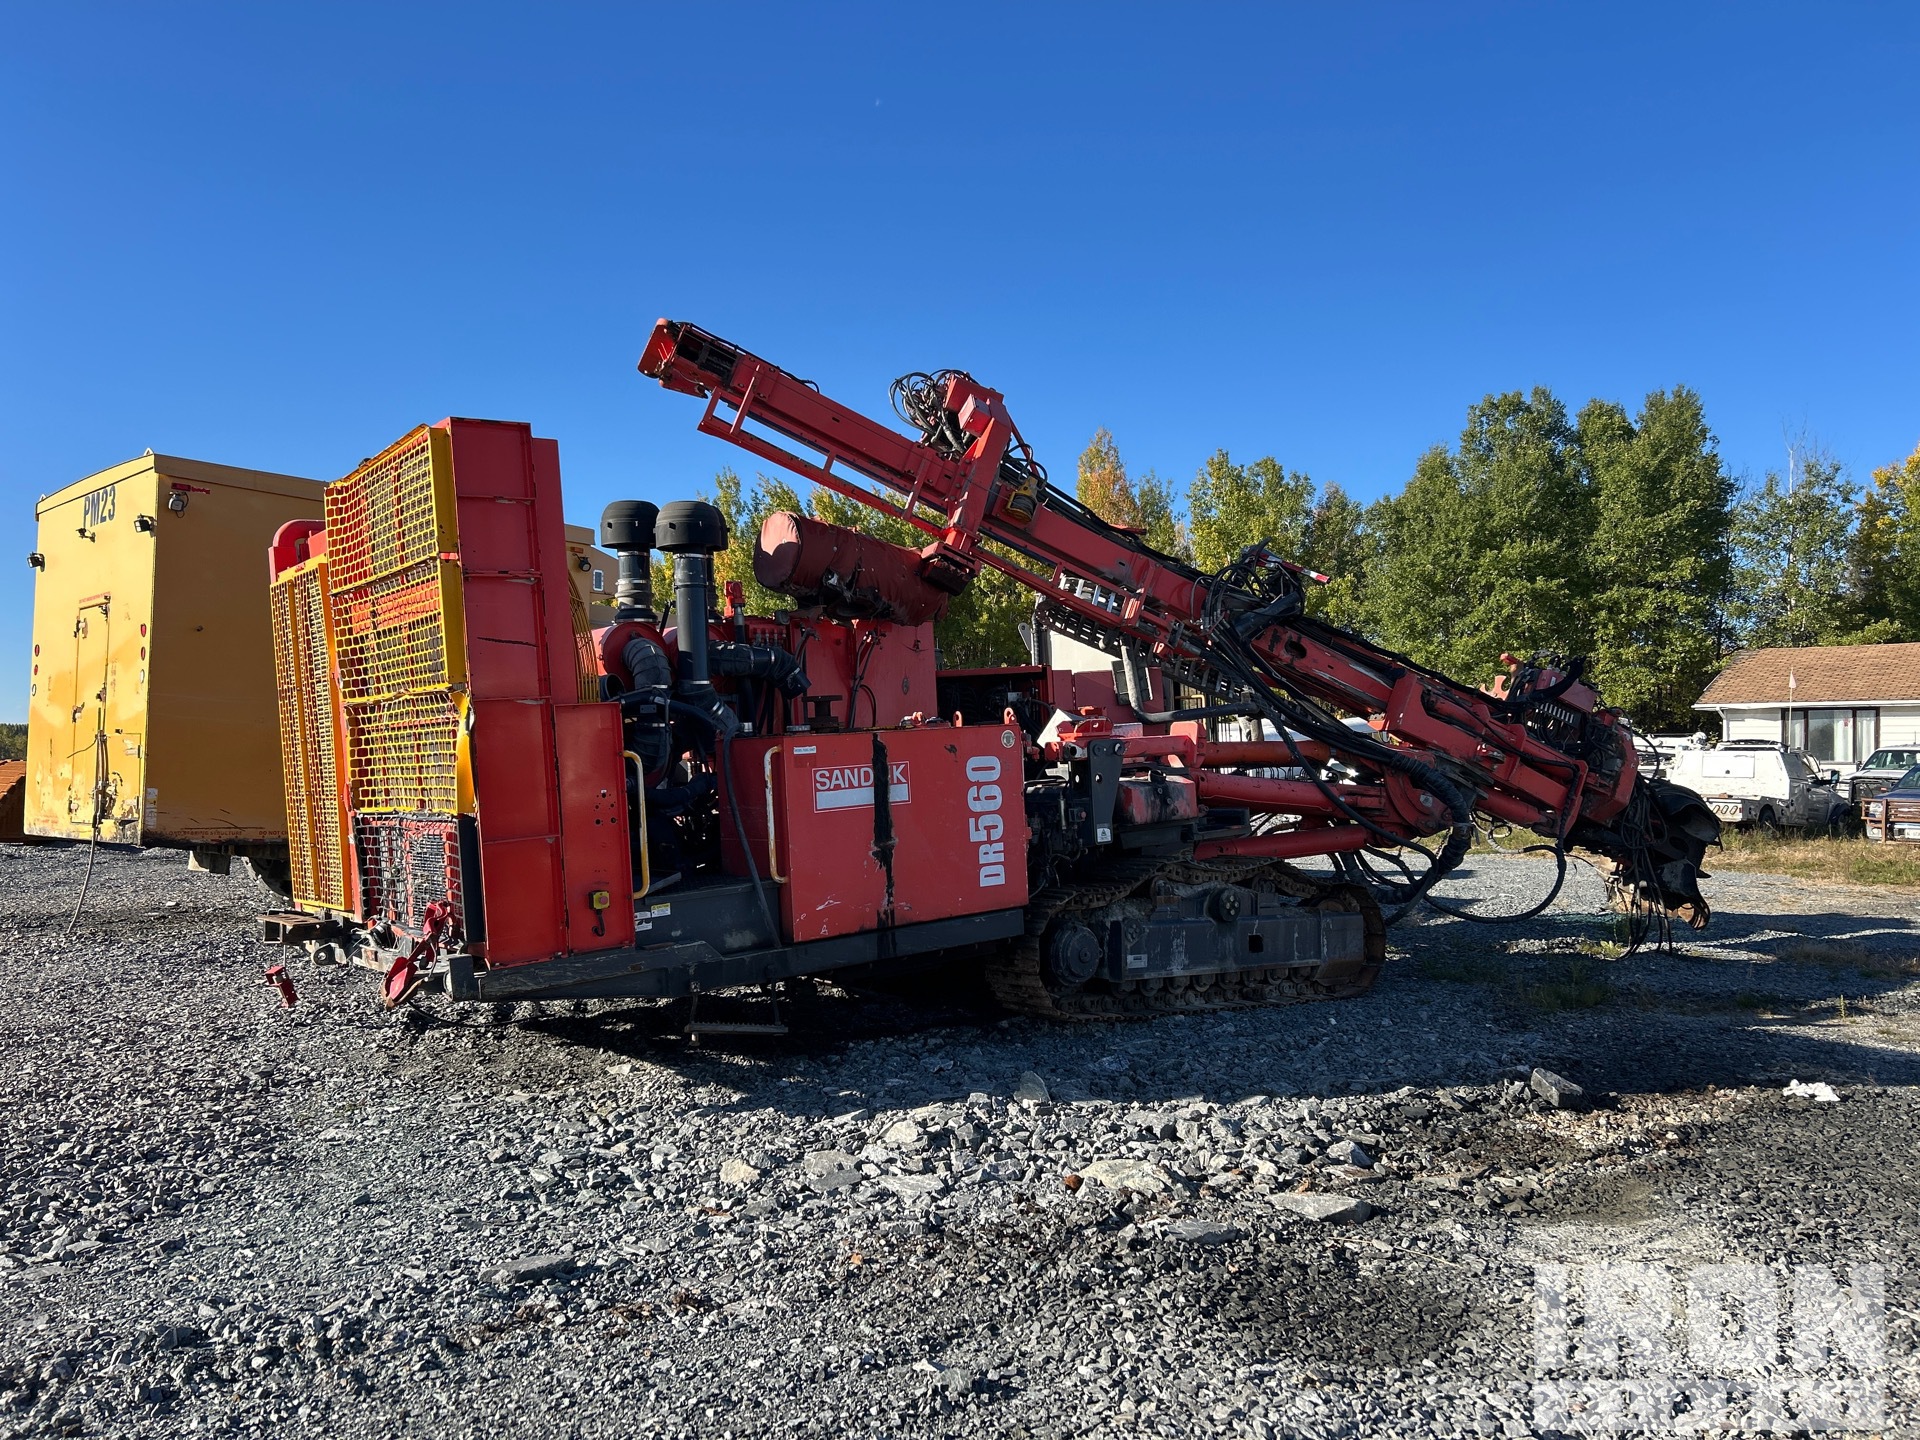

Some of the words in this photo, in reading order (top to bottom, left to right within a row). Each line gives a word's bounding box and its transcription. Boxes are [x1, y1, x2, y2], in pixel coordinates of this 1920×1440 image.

[84, 485, 116, 527] PM23
[815, 764, 907, 790] SANDK
[966, 755, 1006, 887] DR560
